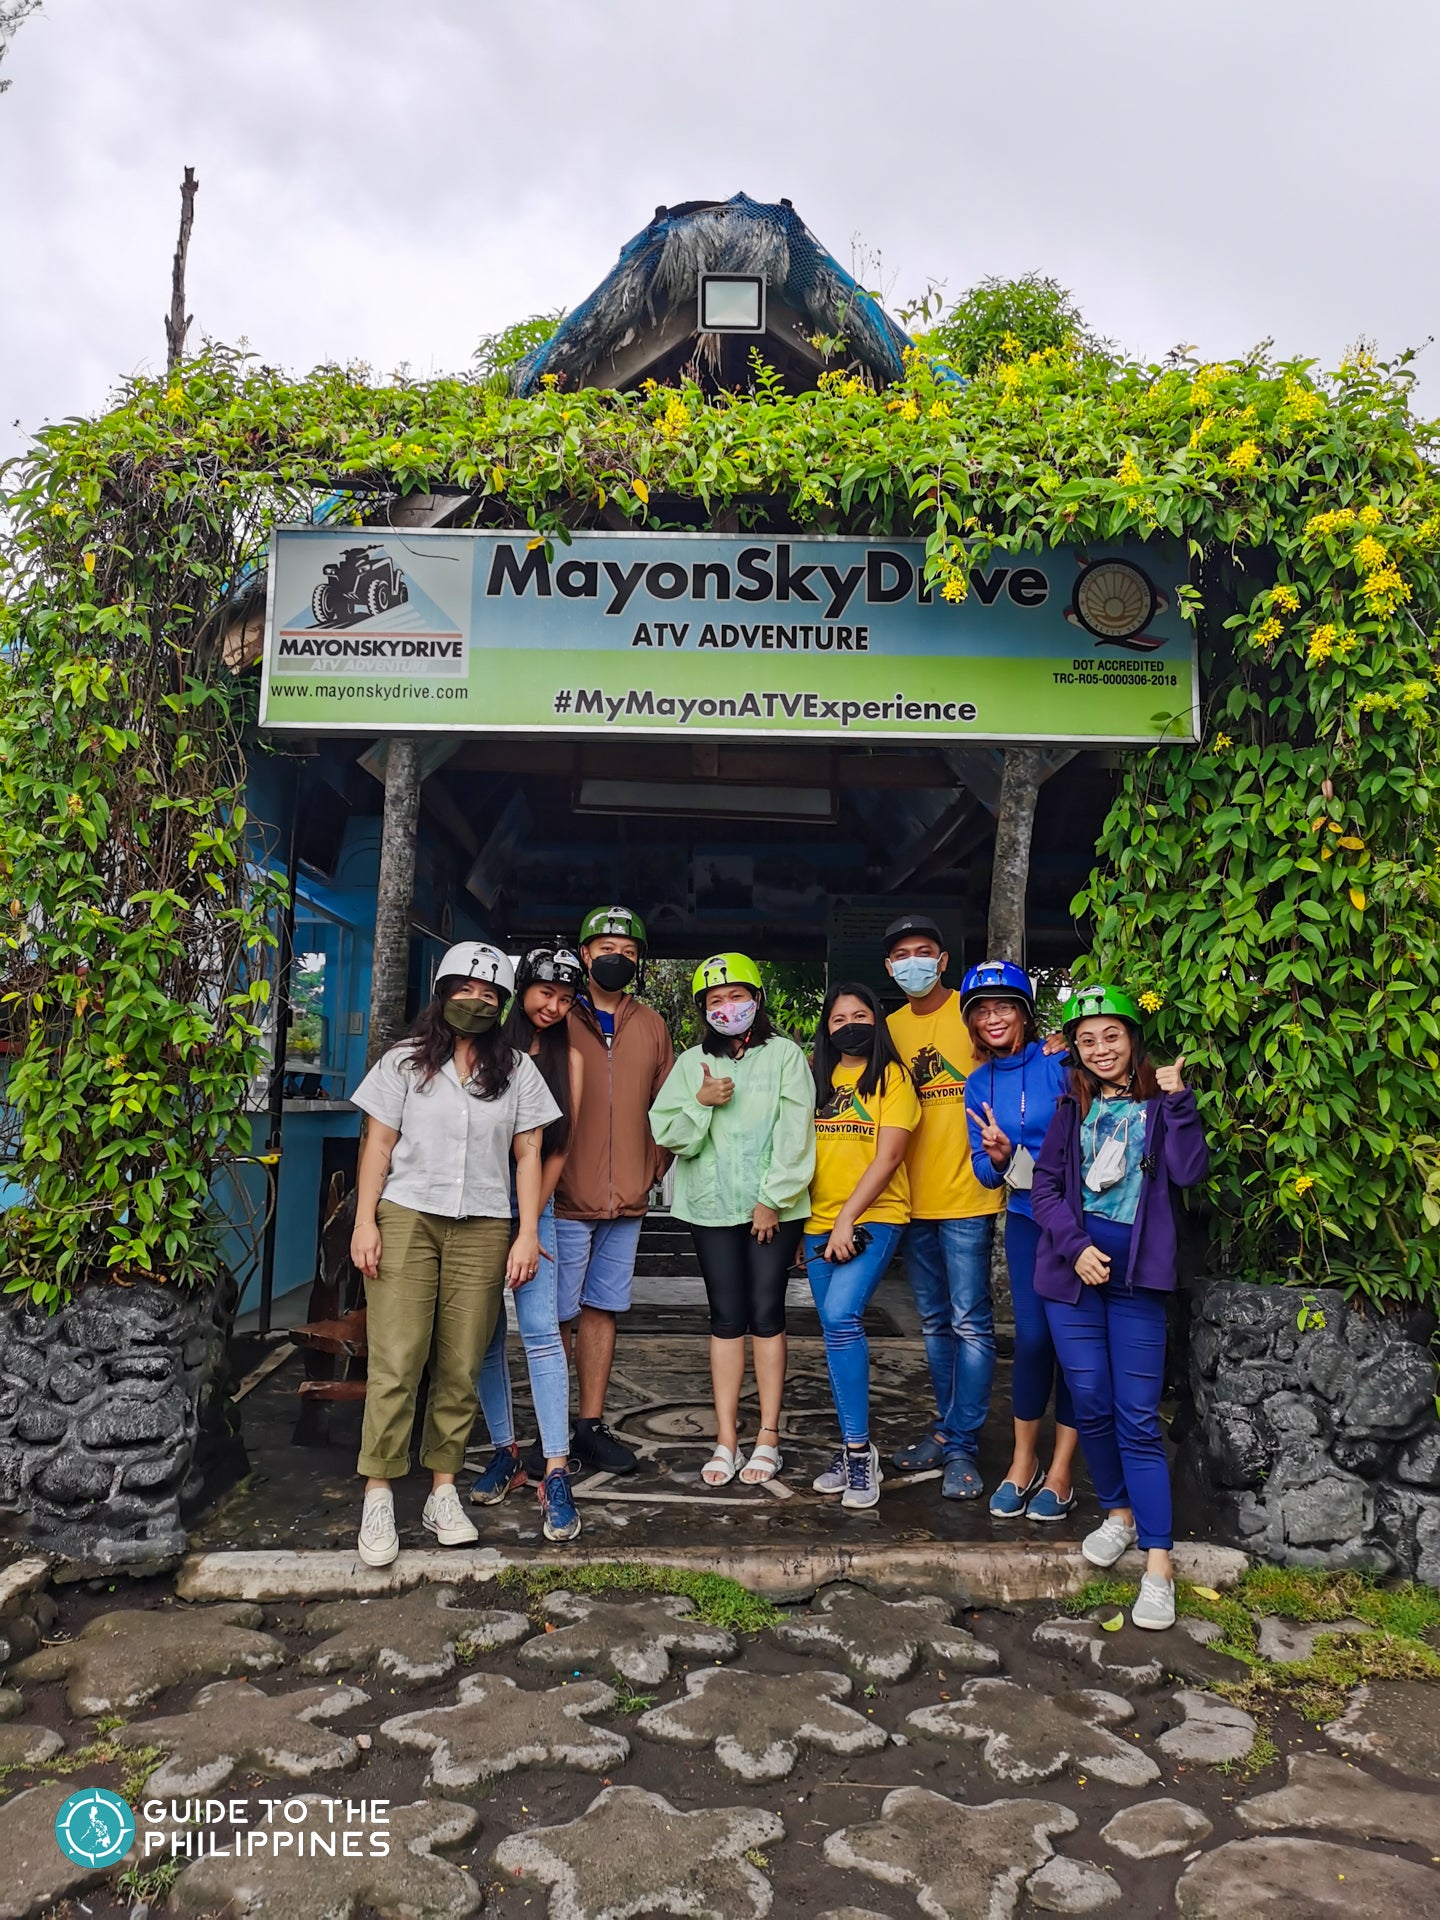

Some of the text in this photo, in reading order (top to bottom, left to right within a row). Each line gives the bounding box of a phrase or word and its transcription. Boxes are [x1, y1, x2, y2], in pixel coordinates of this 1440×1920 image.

[486, 544, 1050, 619] MayonSkyDrve
[632, 622, 868, 650] ATV ADVENTURE
[278, 639, 463, 658] MAYONSKYDRIVE
[311, 659, 429, 672] ATV ADVENTURE
[1073, 659, 1165, 672] DOT ACCREDITED
[1053, 672, 1177, 686] TRC-R05-0000306-2018
[271, 684, 469, 701] www.mayonskydrive.com
[554, 690, 977, 727] #MyMayonATVExperience
[815, 1123, 875, 1136] YONSKYDRIVE
